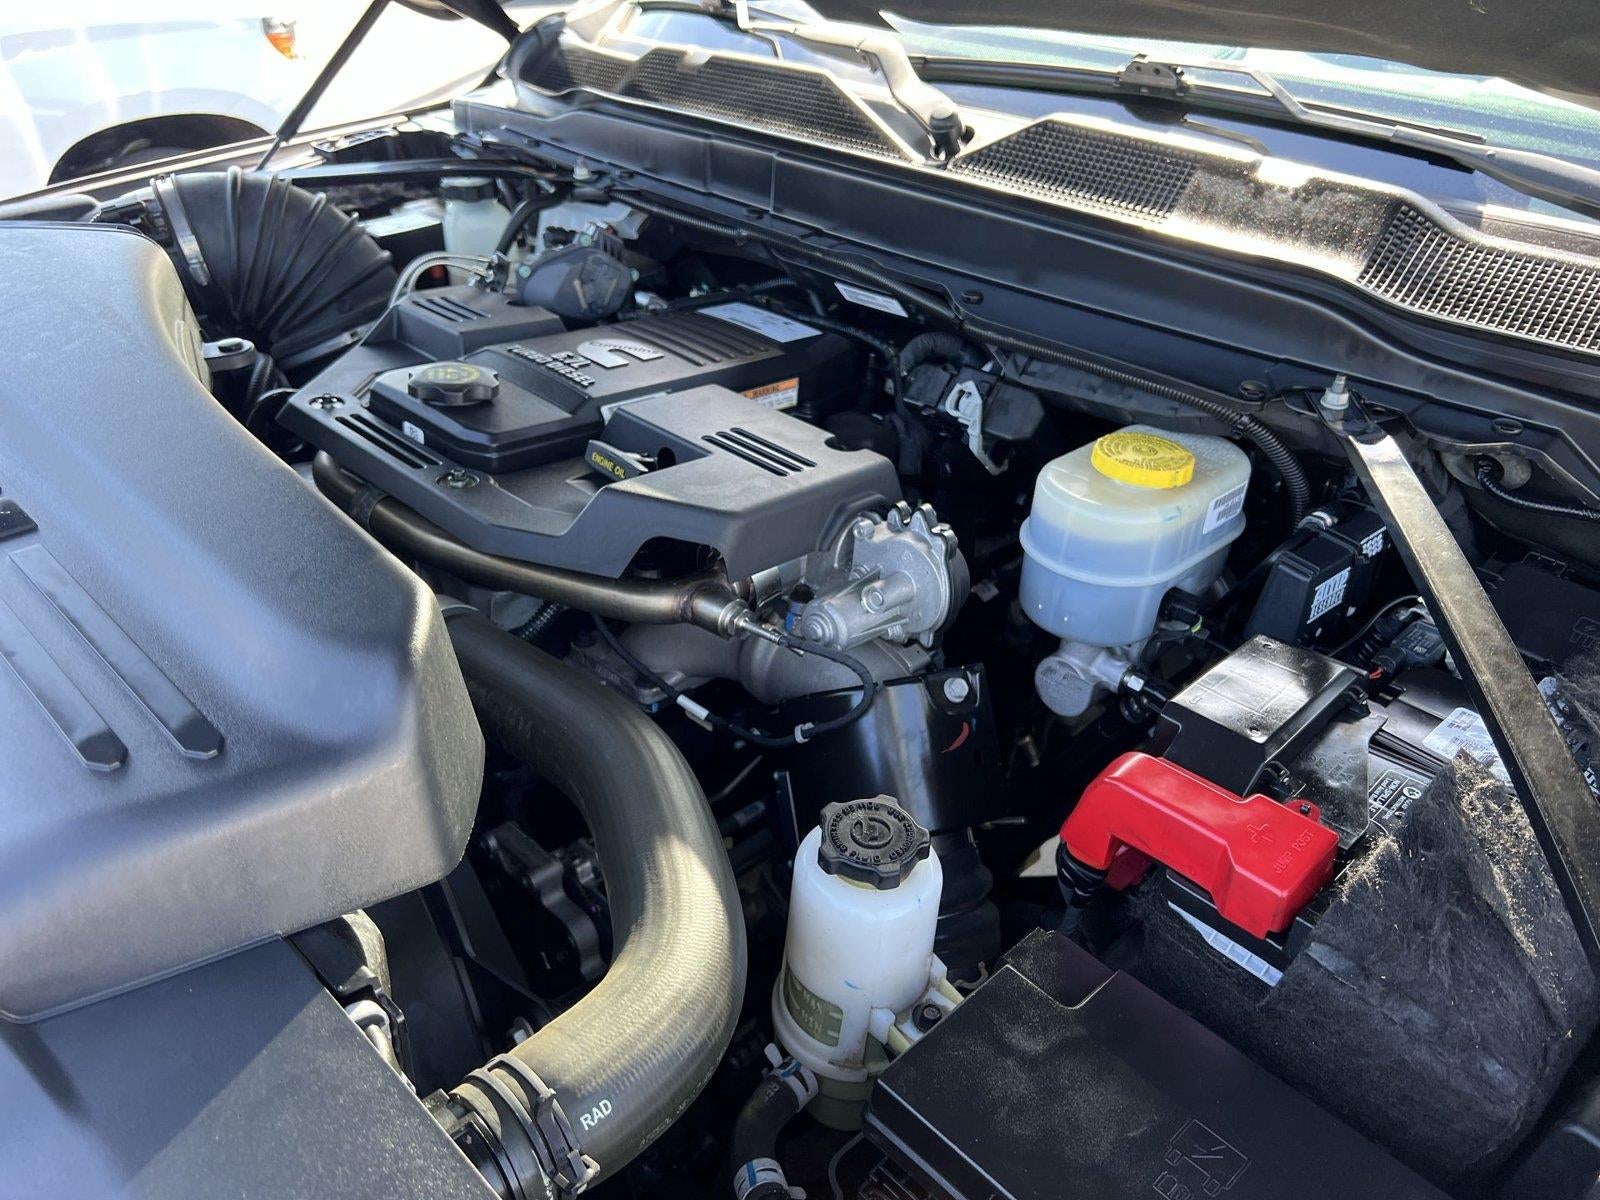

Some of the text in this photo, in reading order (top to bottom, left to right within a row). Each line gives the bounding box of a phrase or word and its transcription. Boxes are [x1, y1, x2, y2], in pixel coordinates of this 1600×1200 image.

[506, 343, 596, 389] TURBO DIESEL
[591, 452, 626, 479] ENGINE OIL
[1272, 828, 1315, 874] JUMP POST
[579, 1099, 613, 1131] RAD
